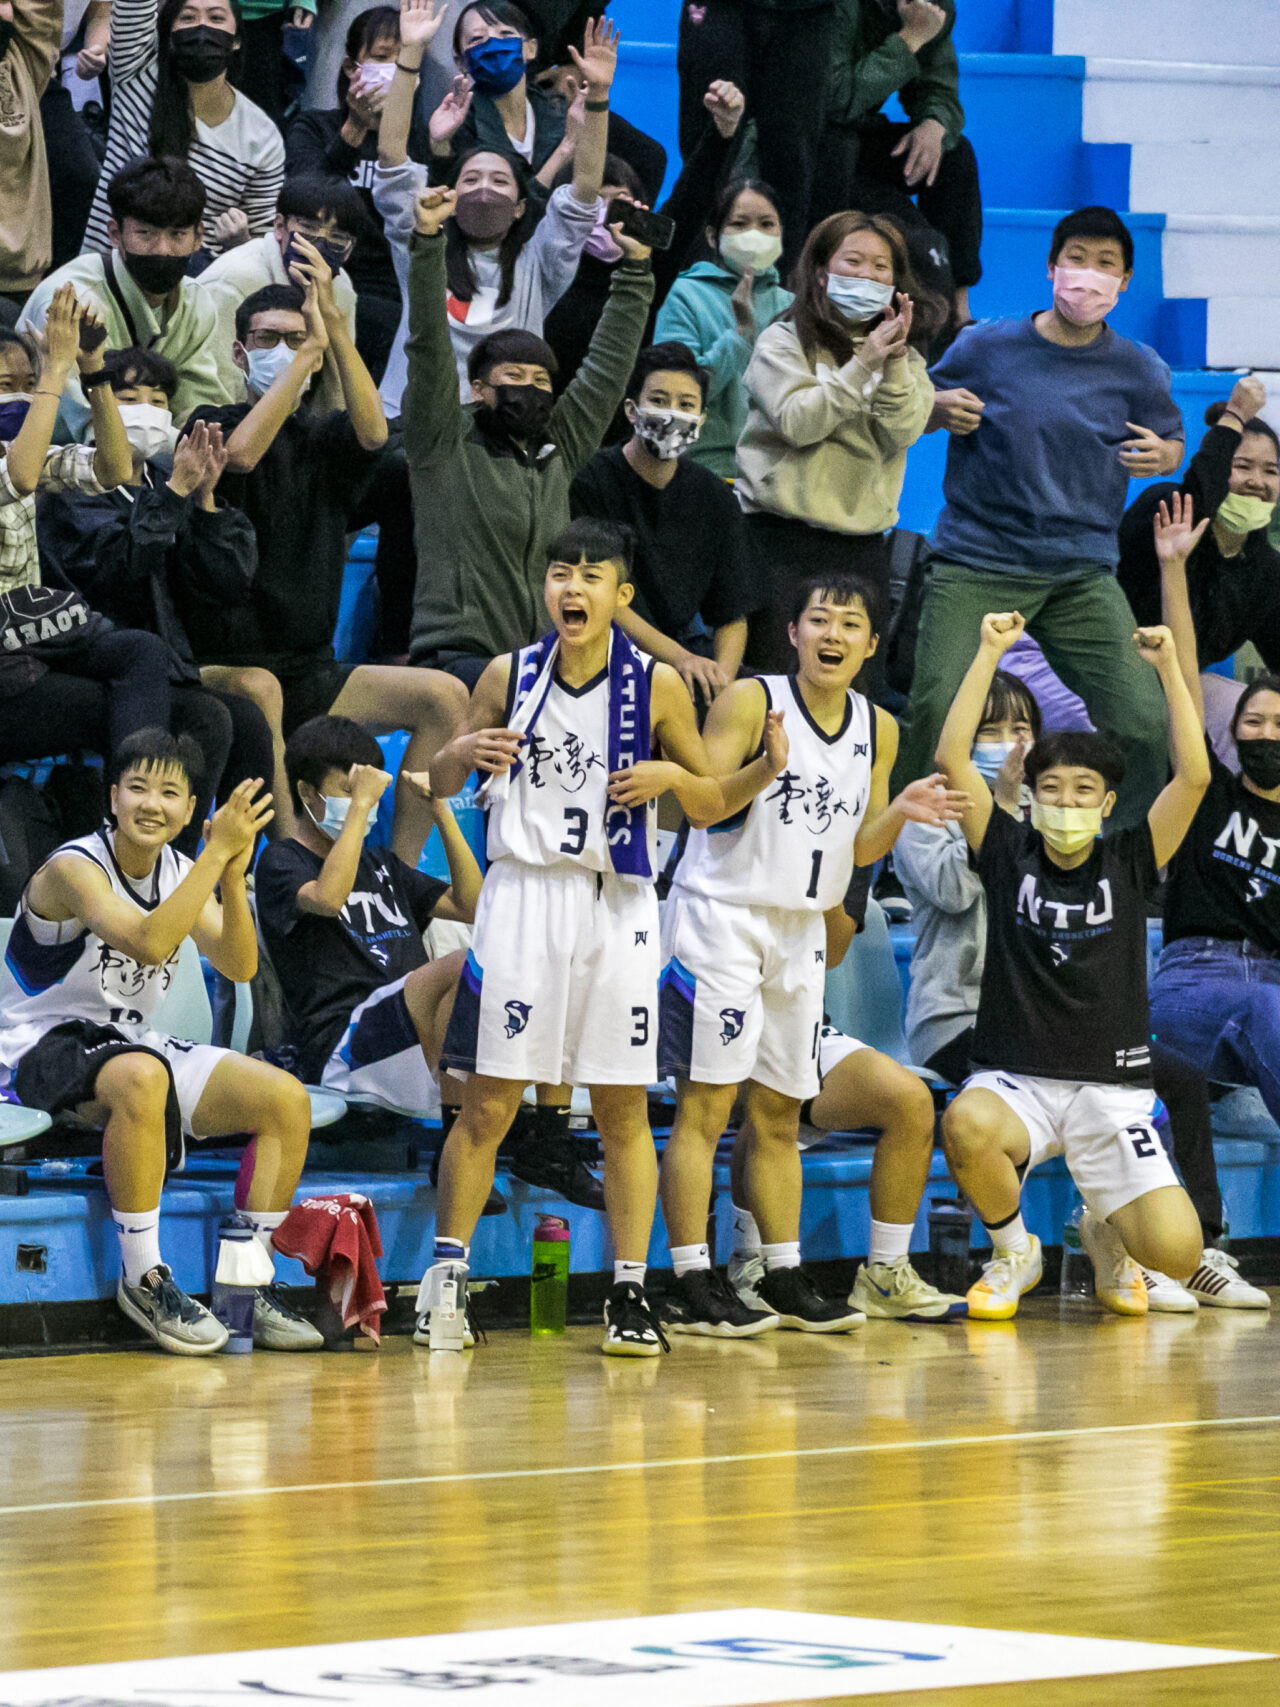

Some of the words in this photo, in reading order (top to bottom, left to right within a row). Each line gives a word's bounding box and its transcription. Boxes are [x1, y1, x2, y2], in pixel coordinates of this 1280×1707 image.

[560, 807, 589, 856] 3
[806, 849, 823, 898] 1
[1017, 873, 1113, 929] NTU
[630, 1006, 649, 1047] 3
[1126, 1127, 1157, 1159] 2
